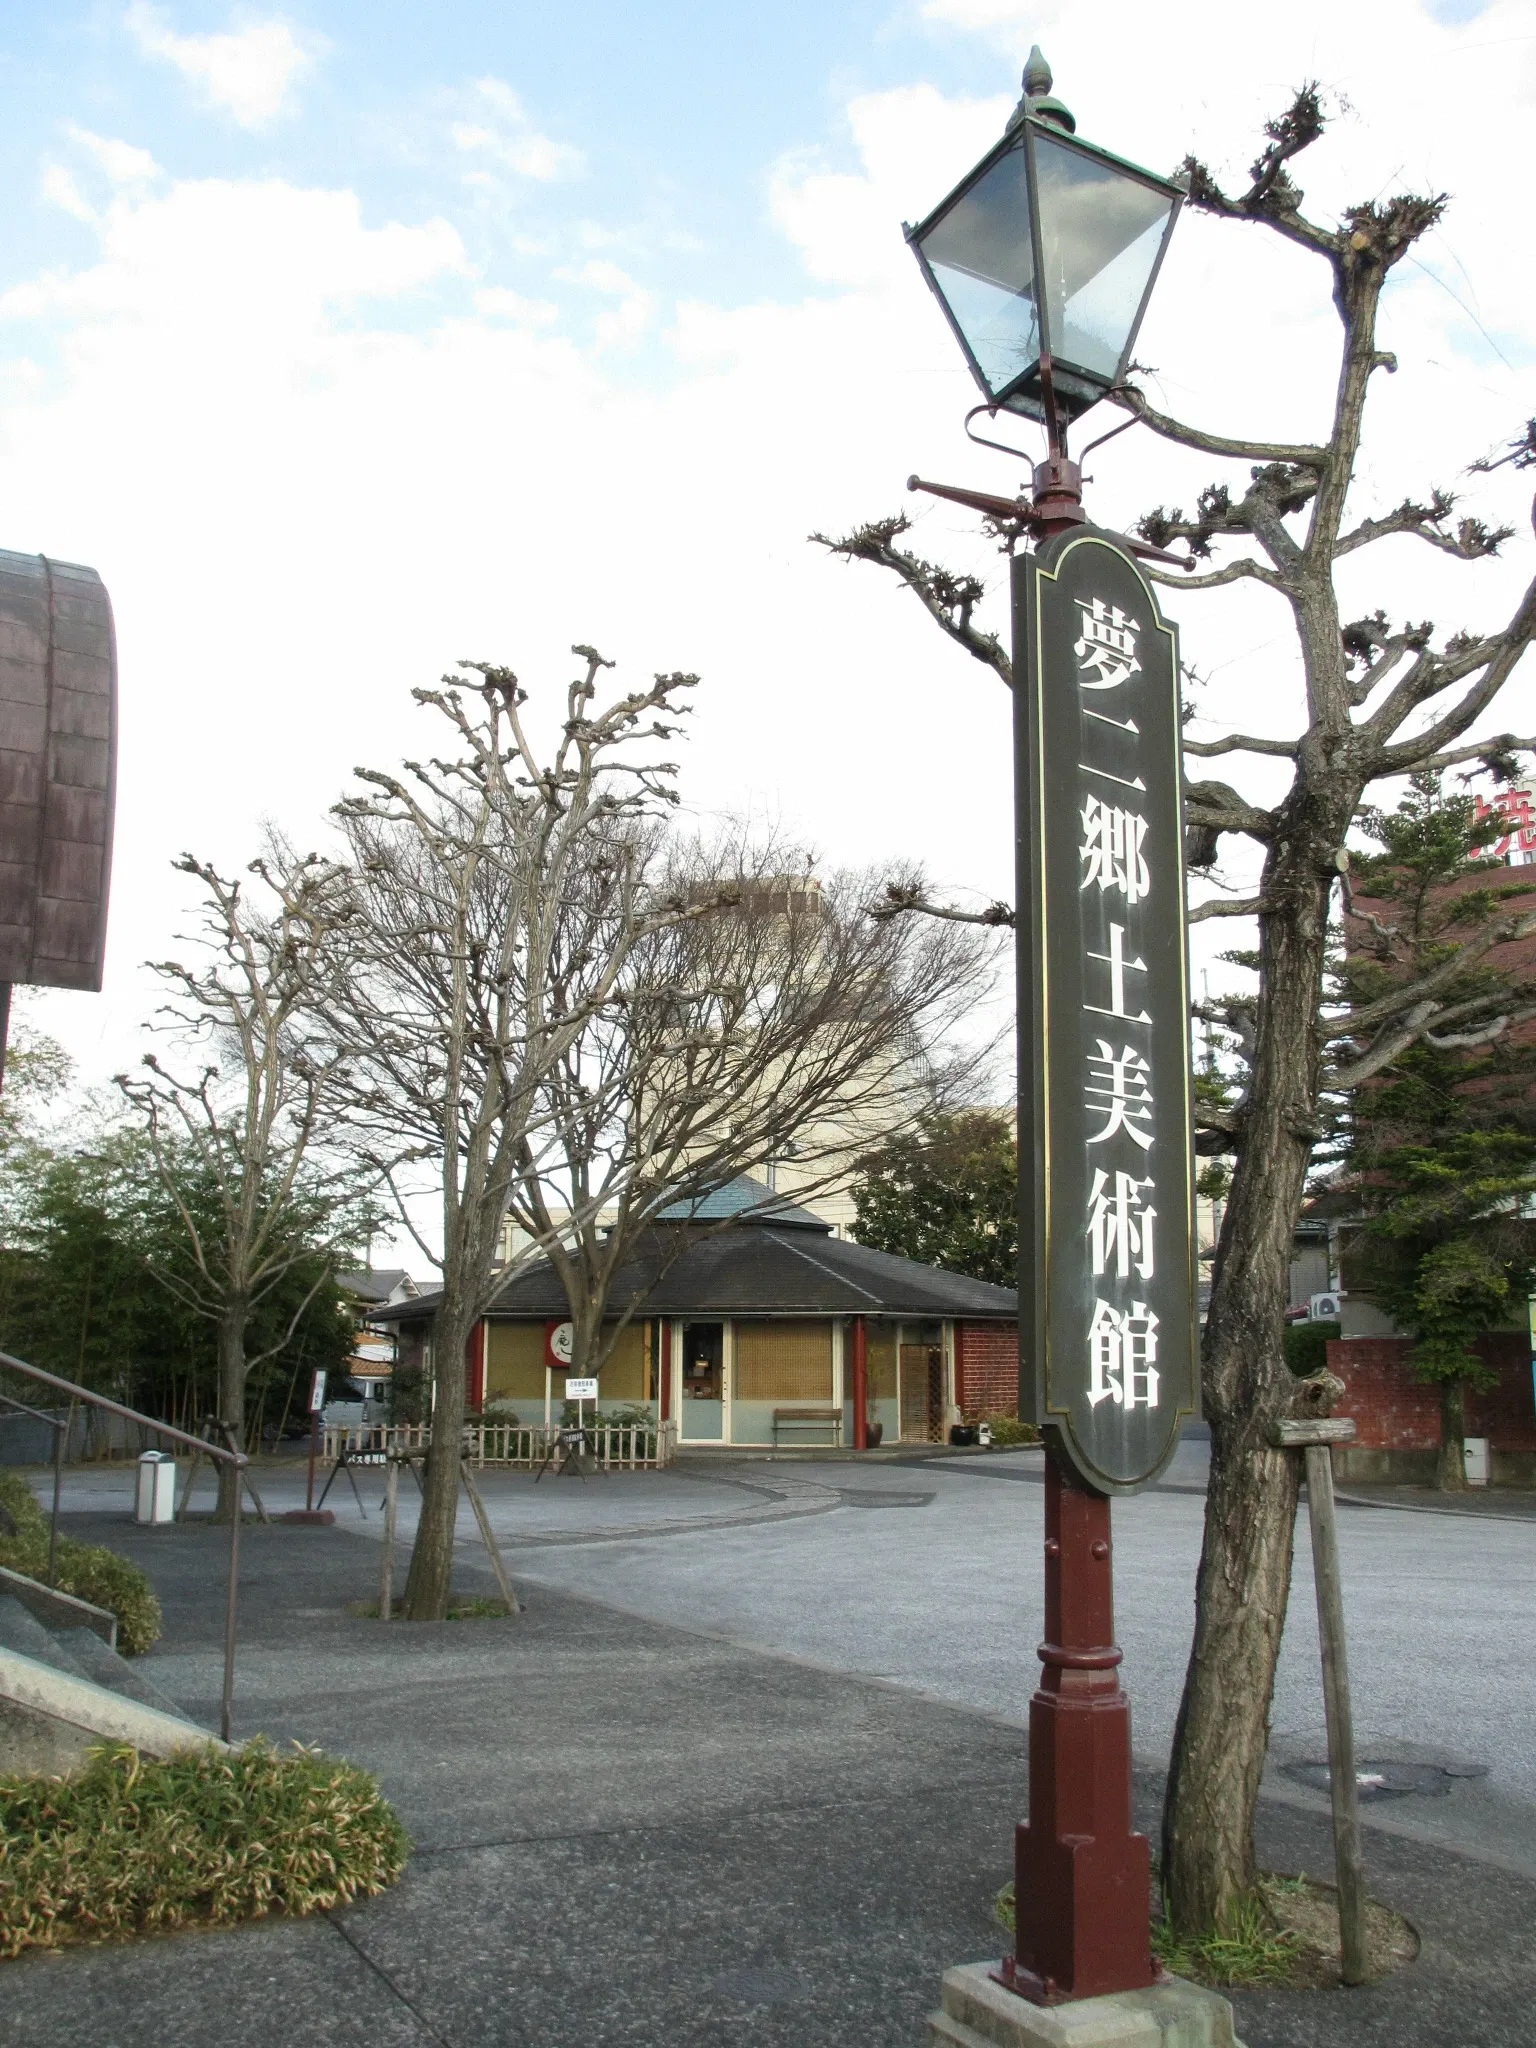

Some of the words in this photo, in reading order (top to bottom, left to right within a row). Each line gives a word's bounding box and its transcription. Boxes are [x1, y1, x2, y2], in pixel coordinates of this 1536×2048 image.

[1074, 597, 1159, 1409] 夢二郷土美術館
